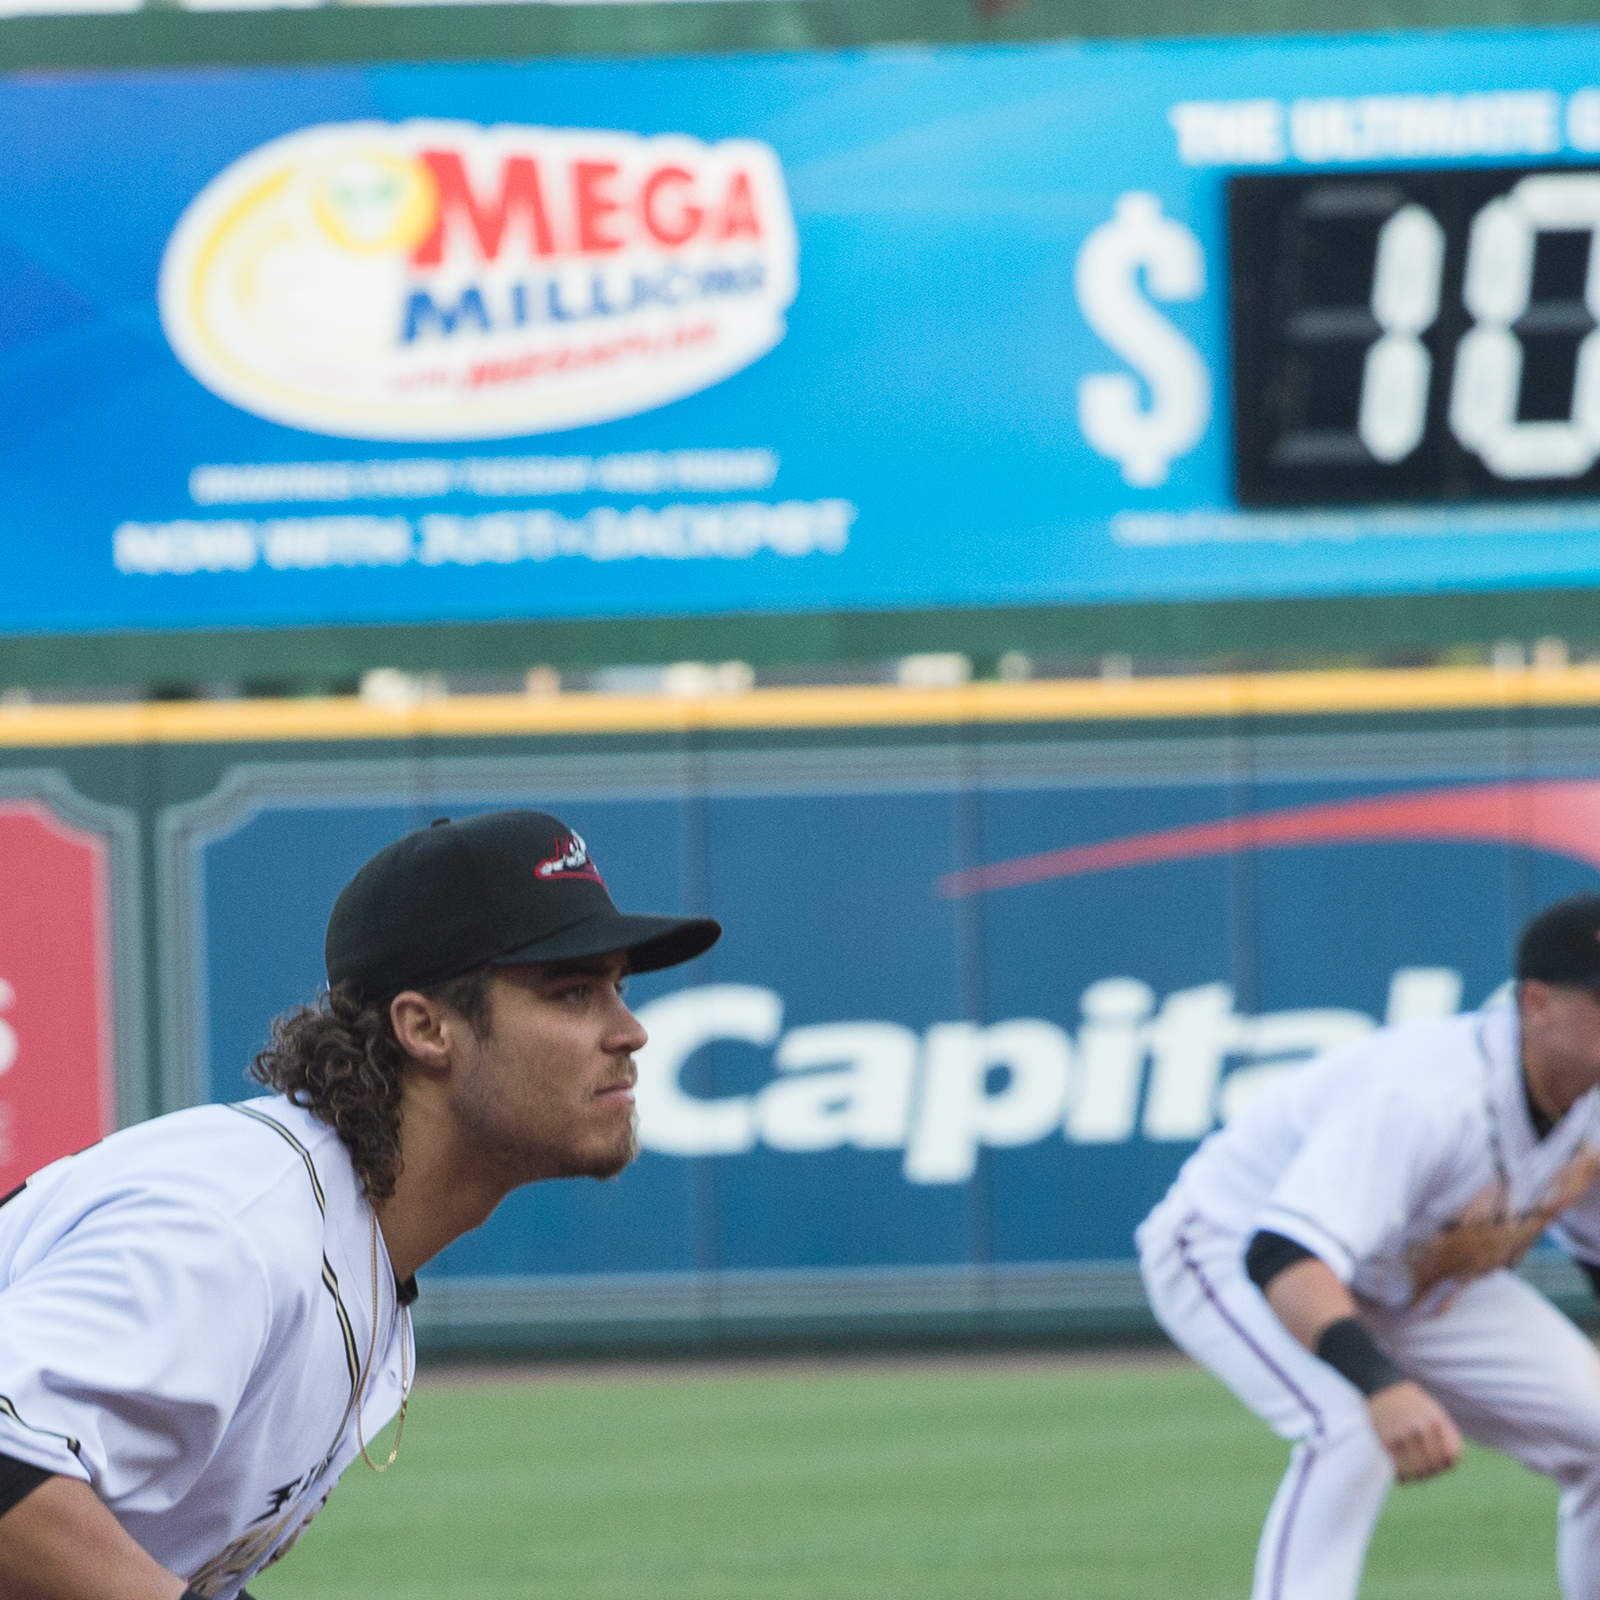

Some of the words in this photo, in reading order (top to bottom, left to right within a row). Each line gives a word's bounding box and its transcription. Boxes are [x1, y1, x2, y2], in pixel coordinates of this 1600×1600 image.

[1170, 101, 1286, 164] THE
[1289, 93, 1563, 156] ULTIMATE
[409, 150, 761, 268] MEGA
[399, 262, 763, 350] MILLIONS
[1073, 189, 1210, 486] $
